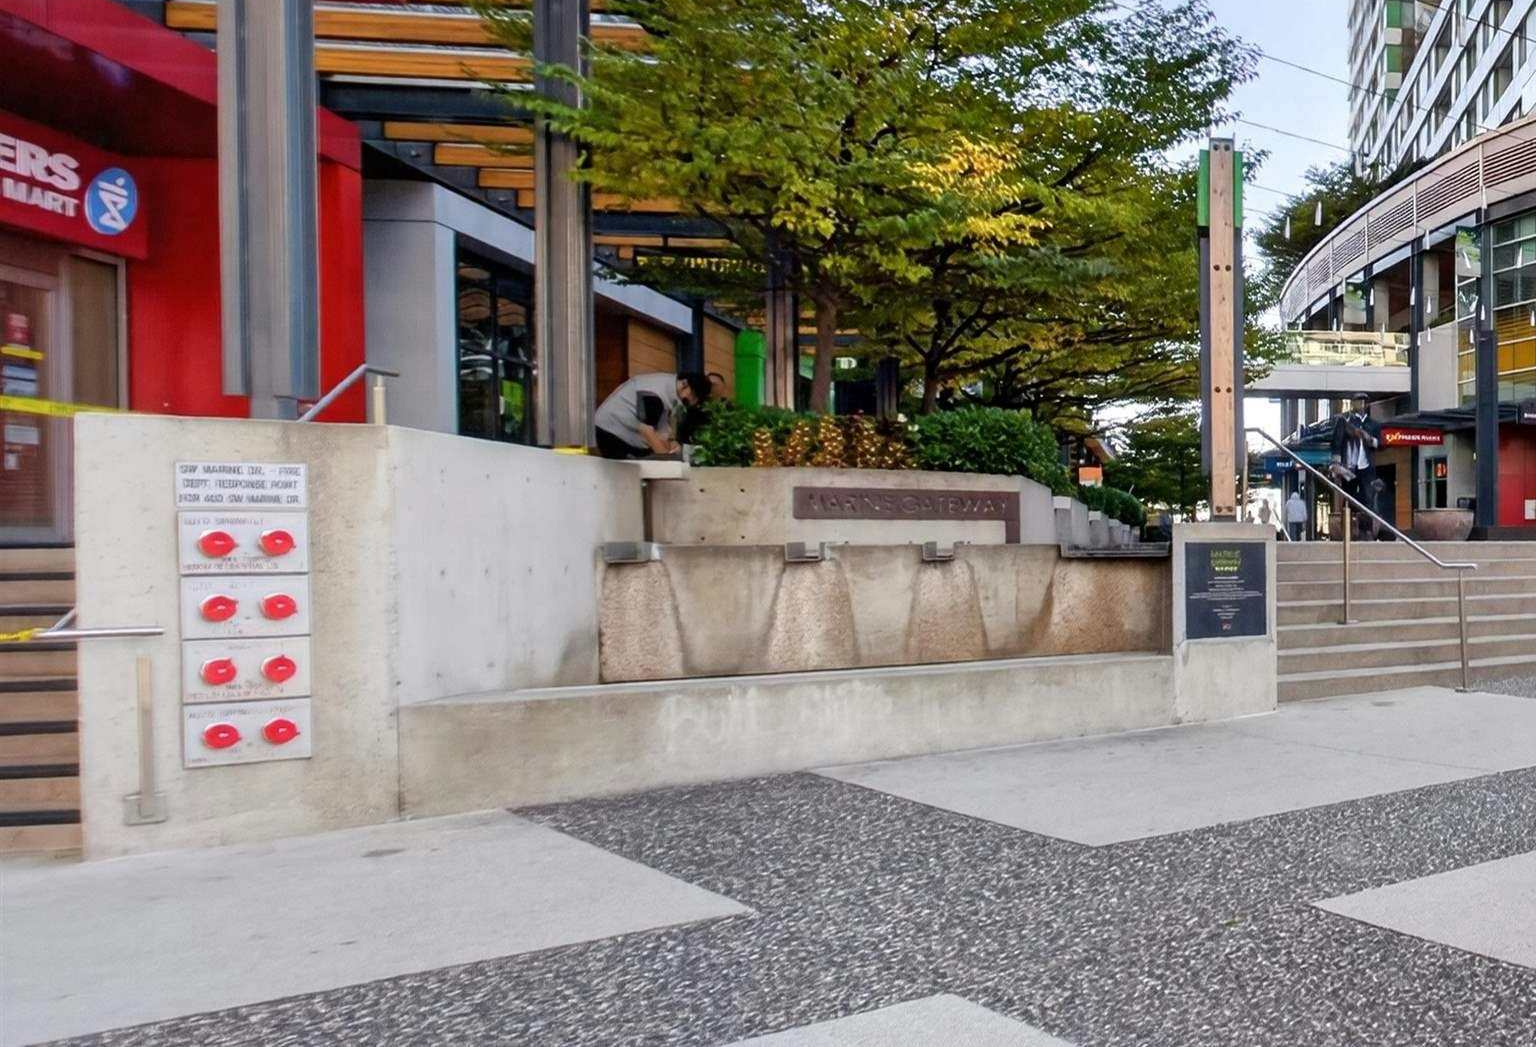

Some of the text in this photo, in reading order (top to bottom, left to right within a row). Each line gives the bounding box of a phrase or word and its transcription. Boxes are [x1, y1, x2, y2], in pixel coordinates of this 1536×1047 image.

[2, 177, 80, 217] MART
[808, 493, 1008, 514] MARINE GATEWAY
